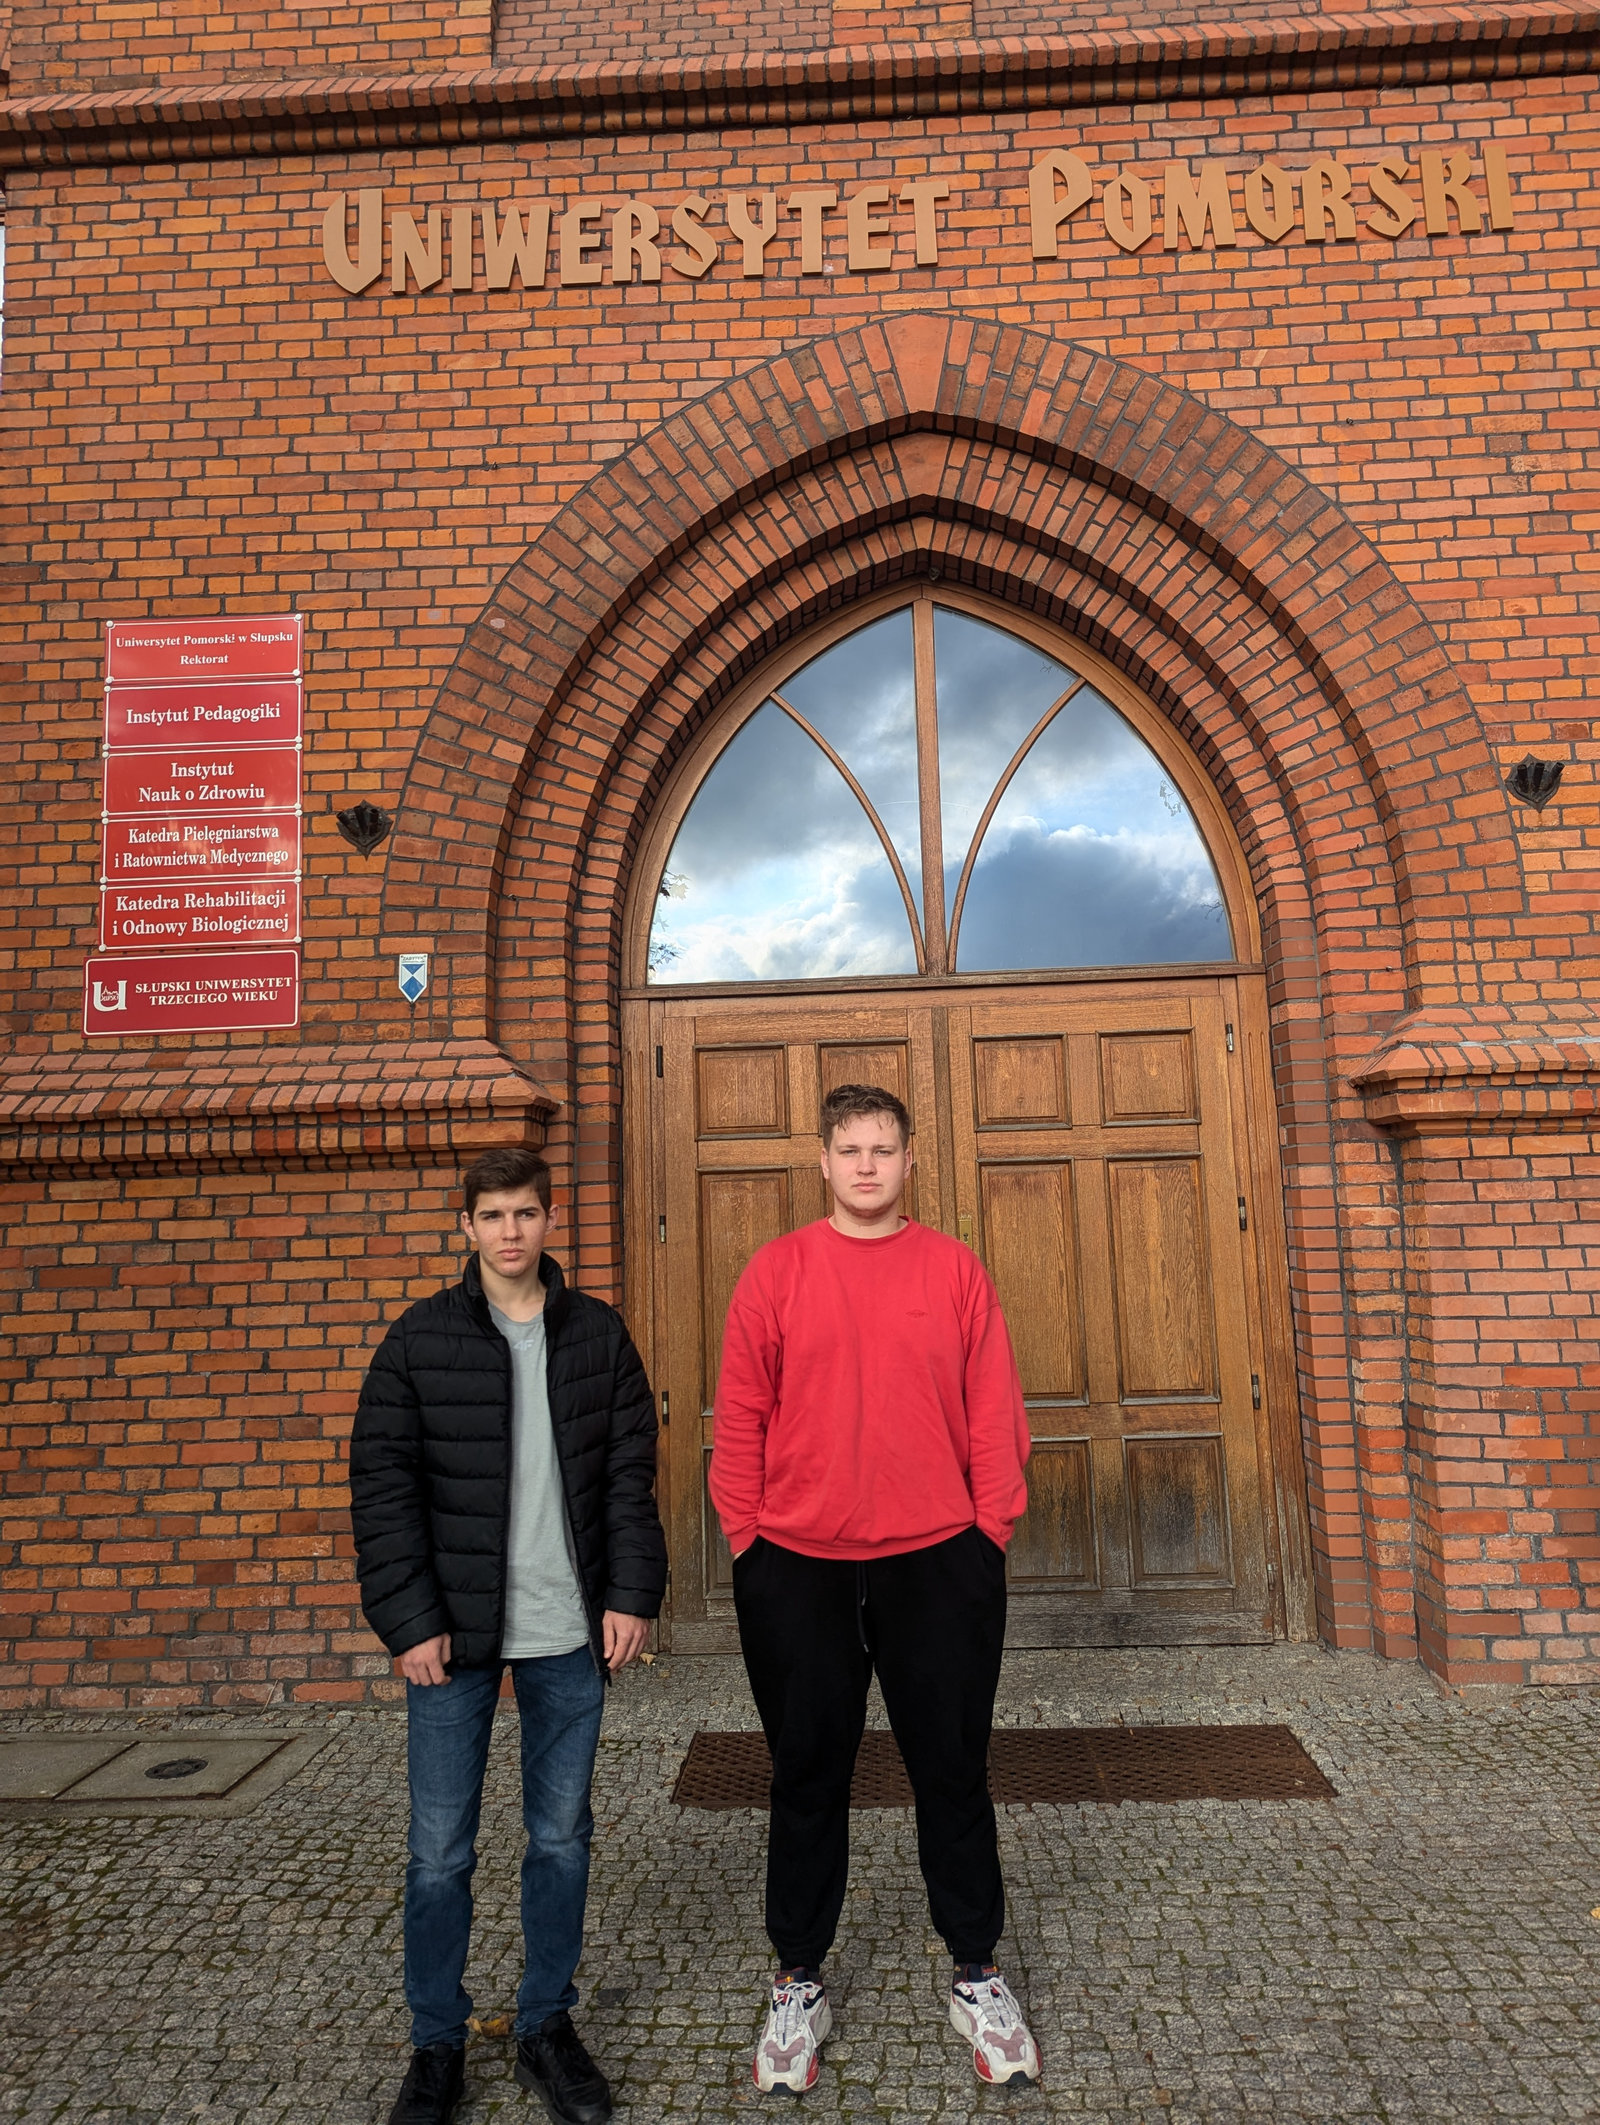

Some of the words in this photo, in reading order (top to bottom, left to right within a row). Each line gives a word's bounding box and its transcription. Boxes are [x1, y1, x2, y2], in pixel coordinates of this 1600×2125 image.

[322, 181, 950, 295] UNIWERSYTET
[1028, 145, 1515, 260] POMORSKI
[116, 636, 181, 649] Uniwersytet
[183, 633, 235, 645] Pomorski
[238, 635, 247, 643] w
[250, 631, 293, 644] Słupsku
[180, 654, 228, 665] Rektorat
[126, 708, 189, 726] Instytut
[193, 702, 281, 723] Pedagogiki
[171, 761, 235, 780] Instytut
[138, 785, 181, 803] Nauk
[185, 790, 195, 801] o
[198, 783, 265, 800] Zdrowiu
[128, 827, 180, 844] Katedra
[183, 824, 280, 844] Pielęgniarstwa
[114, 852, 120, 868] i
[122, 850, 207, 868] Ratownictwa
[210, 848, 289, 867] Medycznego
[116, 894, 180, 912] Katedra
[184, 889, 286, 909] Rehabilitacji
[112, 920, 118, 936] i
[122, 919, 188, 937] Odnowy
[191, 913, 289, 935] Biologicznej
[135, 982, 191, 994] SŁUPSKI
[195, 977, 293, 990] UNIWERSYTET
[149, 994, 228, 1006] TRZECIEGO
[231, 990, 278, 1002] WIEKU
[512, 1339, 534, 1351] 4F
